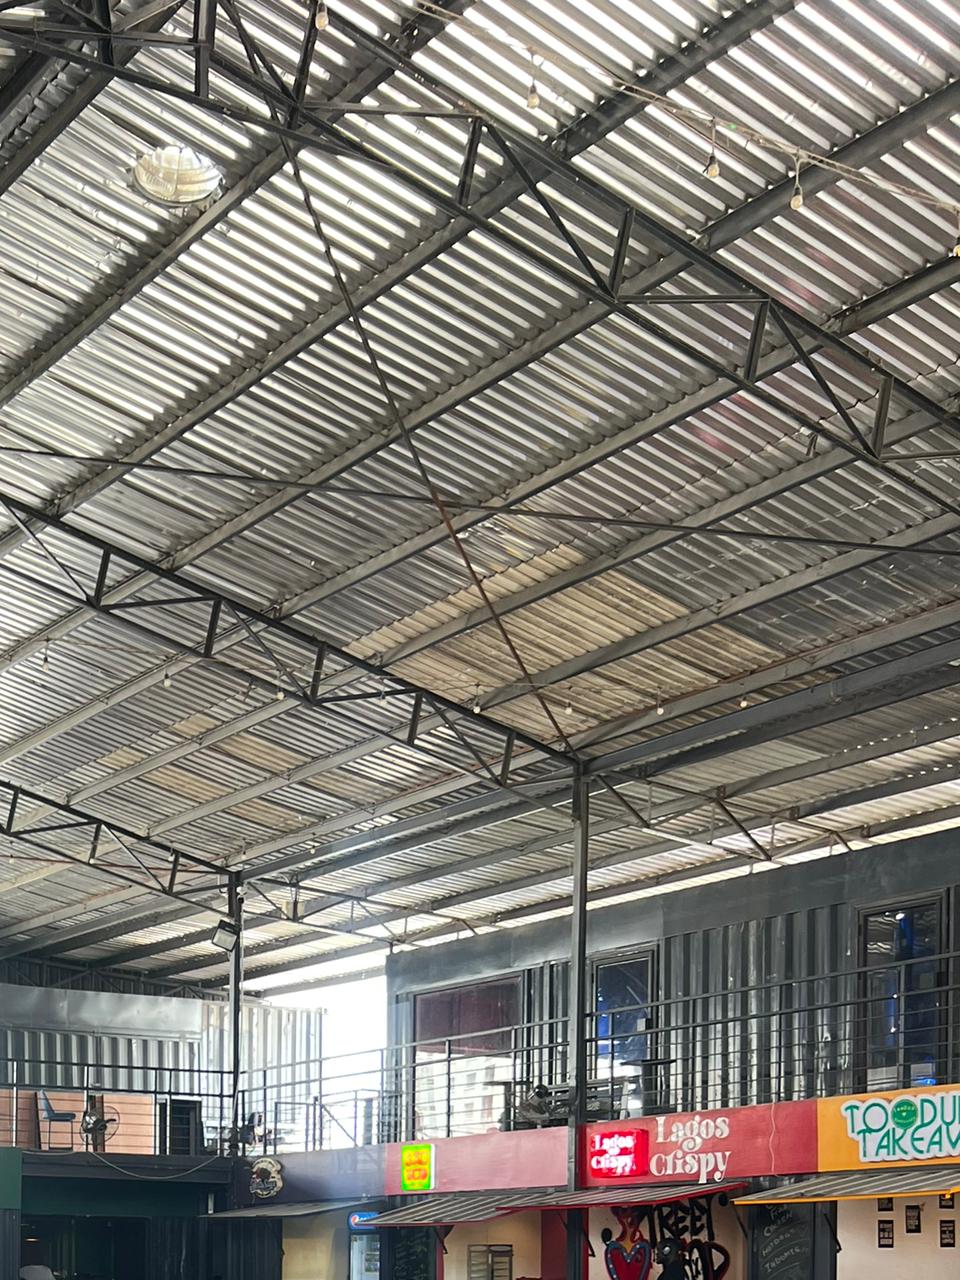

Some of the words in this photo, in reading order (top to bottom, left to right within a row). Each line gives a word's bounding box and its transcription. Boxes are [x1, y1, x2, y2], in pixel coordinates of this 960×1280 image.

[844, 1095, 960, 1134] TOODU
[592, 1134, 634, 1155] Lagos
[655, 1115, 730, 1152] Lagos
[649, 1150, 732, 1184] Crispy
